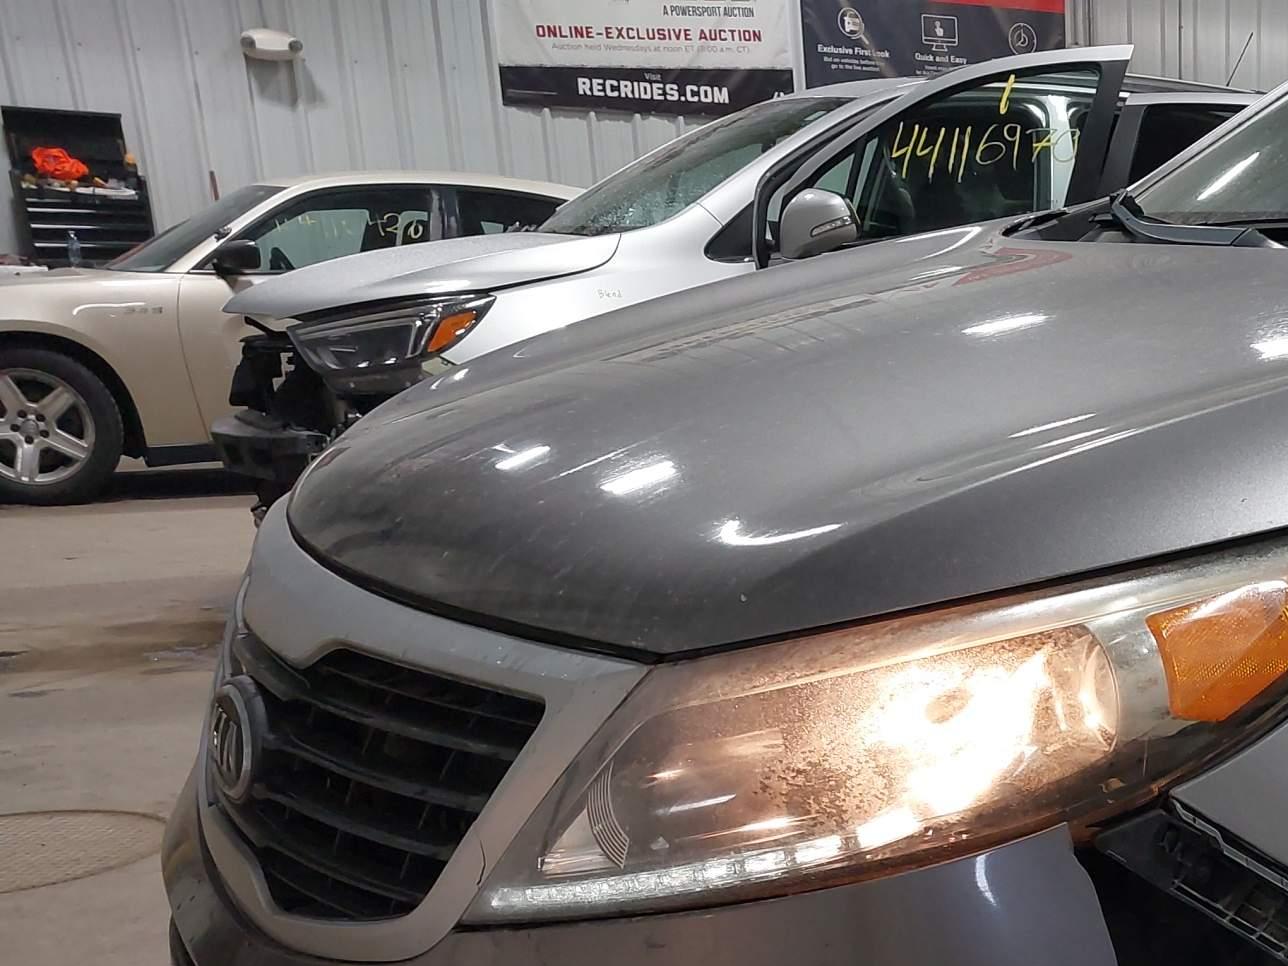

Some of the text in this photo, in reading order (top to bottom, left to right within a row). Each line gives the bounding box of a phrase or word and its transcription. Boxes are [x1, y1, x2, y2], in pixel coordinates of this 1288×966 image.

[663, 5, 755, 17] A POWERSPORT AUCTION
[536, 24, 762, 42] ONLINE-EXCLUSIVE AUCTION
[817, 44, 853, 55] Exclusive
[854, 47, 871, 57] First
[914, 52, 968, 65] Quick and Easy
[576, 77, 730, 104] RECRIDES.COM
